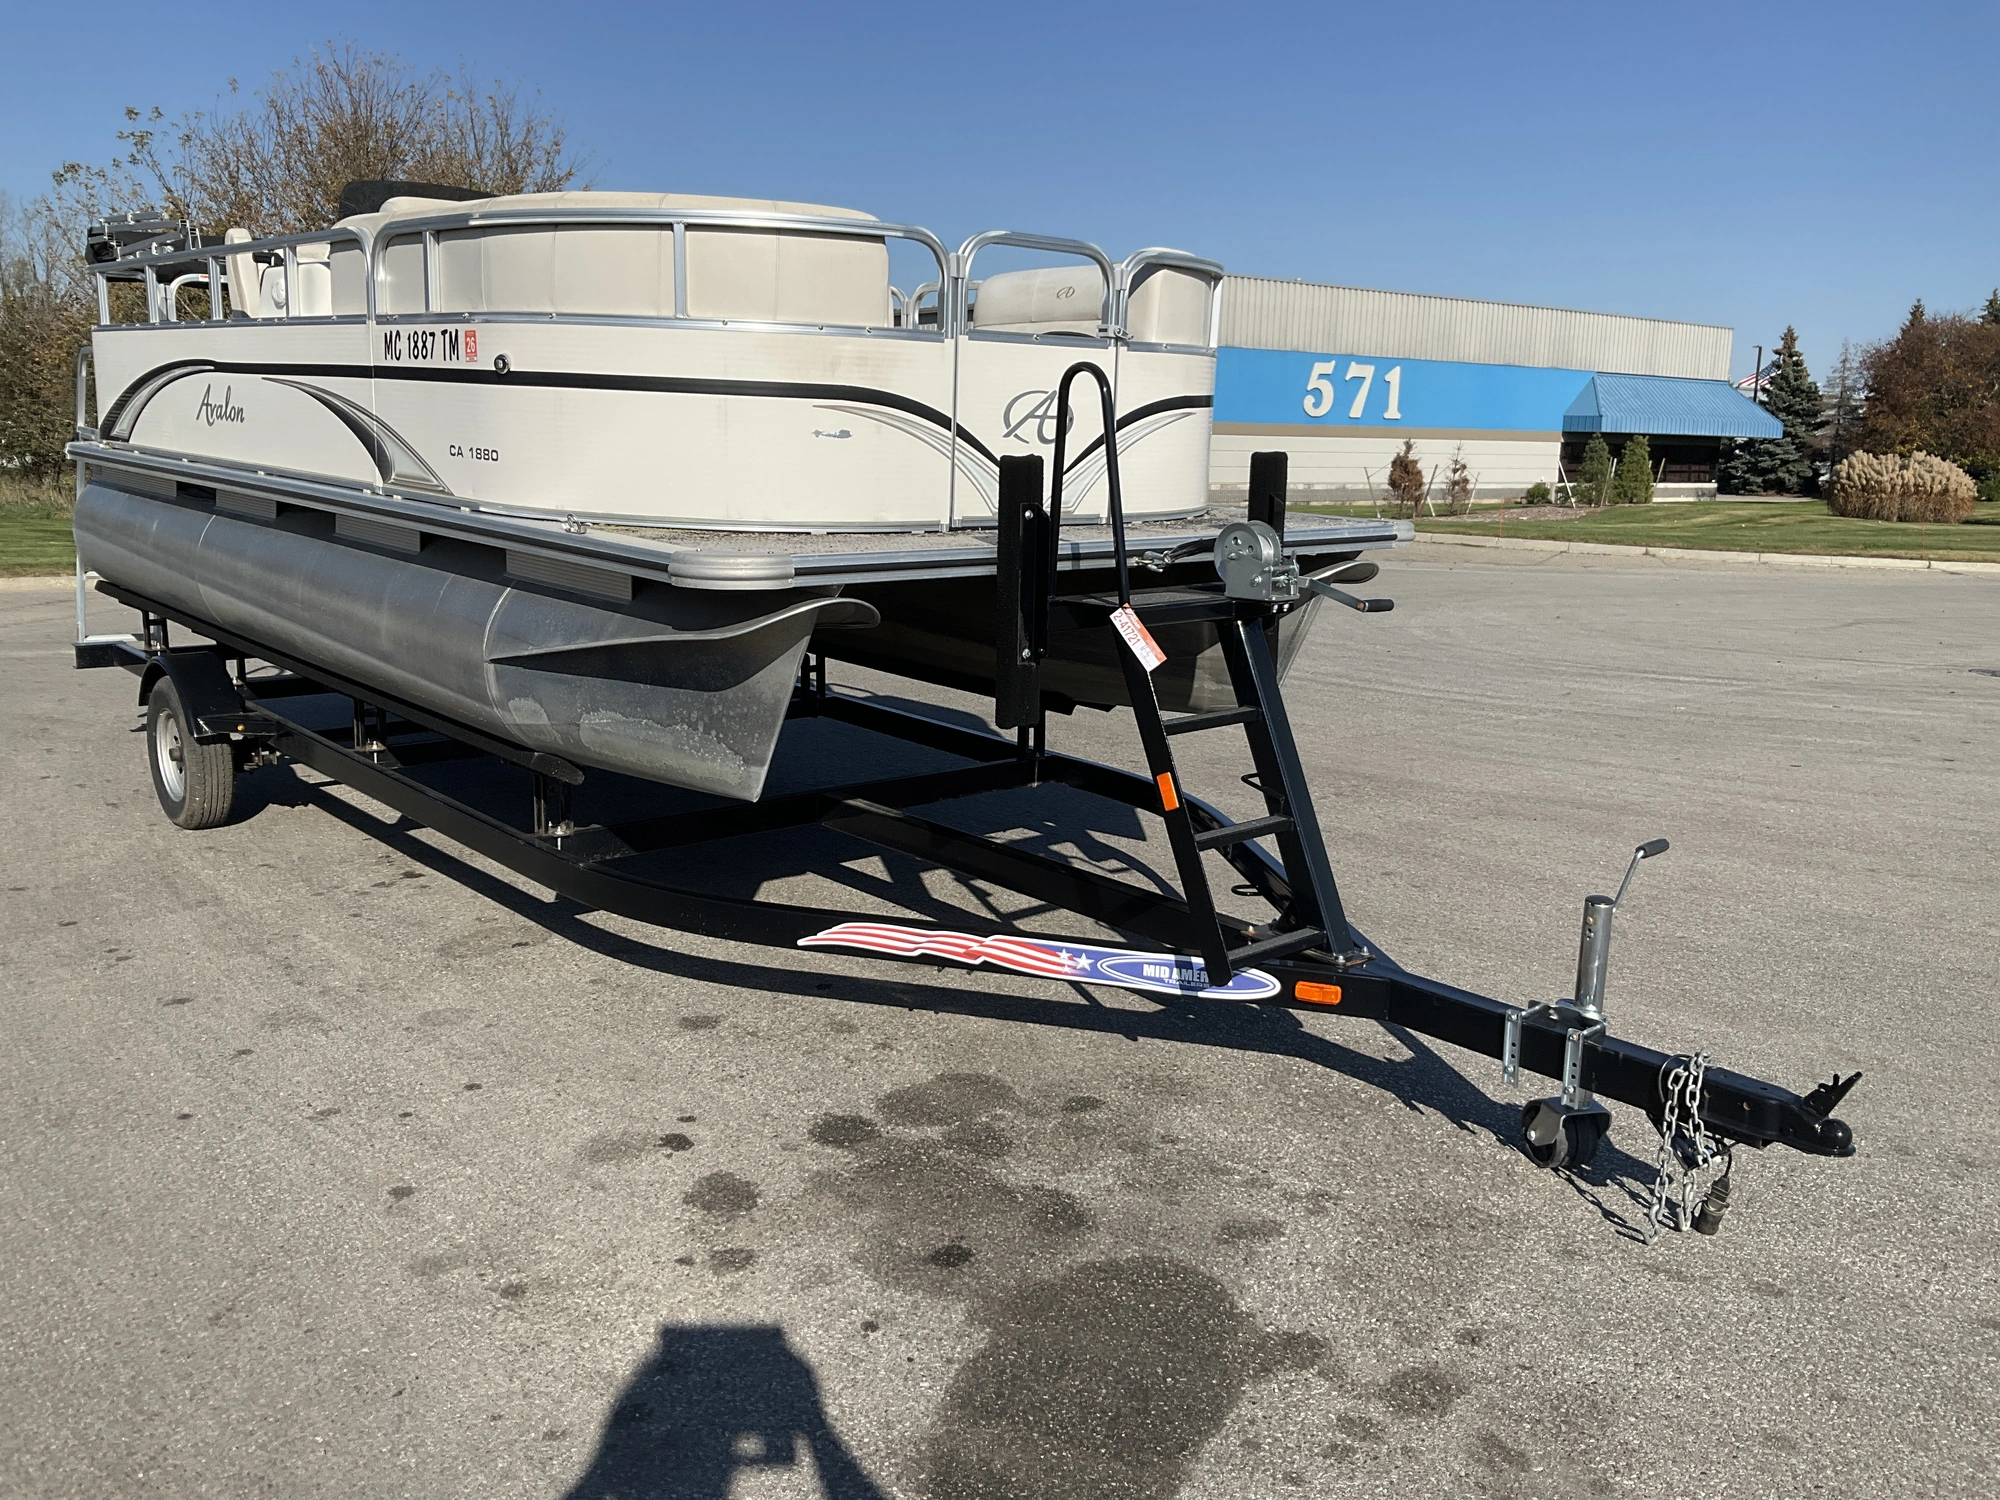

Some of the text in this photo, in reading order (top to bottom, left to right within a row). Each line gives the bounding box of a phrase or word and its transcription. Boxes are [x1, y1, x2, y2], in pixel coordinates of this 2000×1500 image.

[384, 329, 460, 361] MC 1887 TM
[466, 337, 476, 353] 26
[1303, 360, 1401, 419] 571
[196, 383, 245, 427] Avalon
[449, 444, 499, 462] CA 1880
[1113, 611, 1141, 646] 2-41721
[1143, 964, 1170, 979] MID
[1163, 978, 1210, 988] TRAILERS
